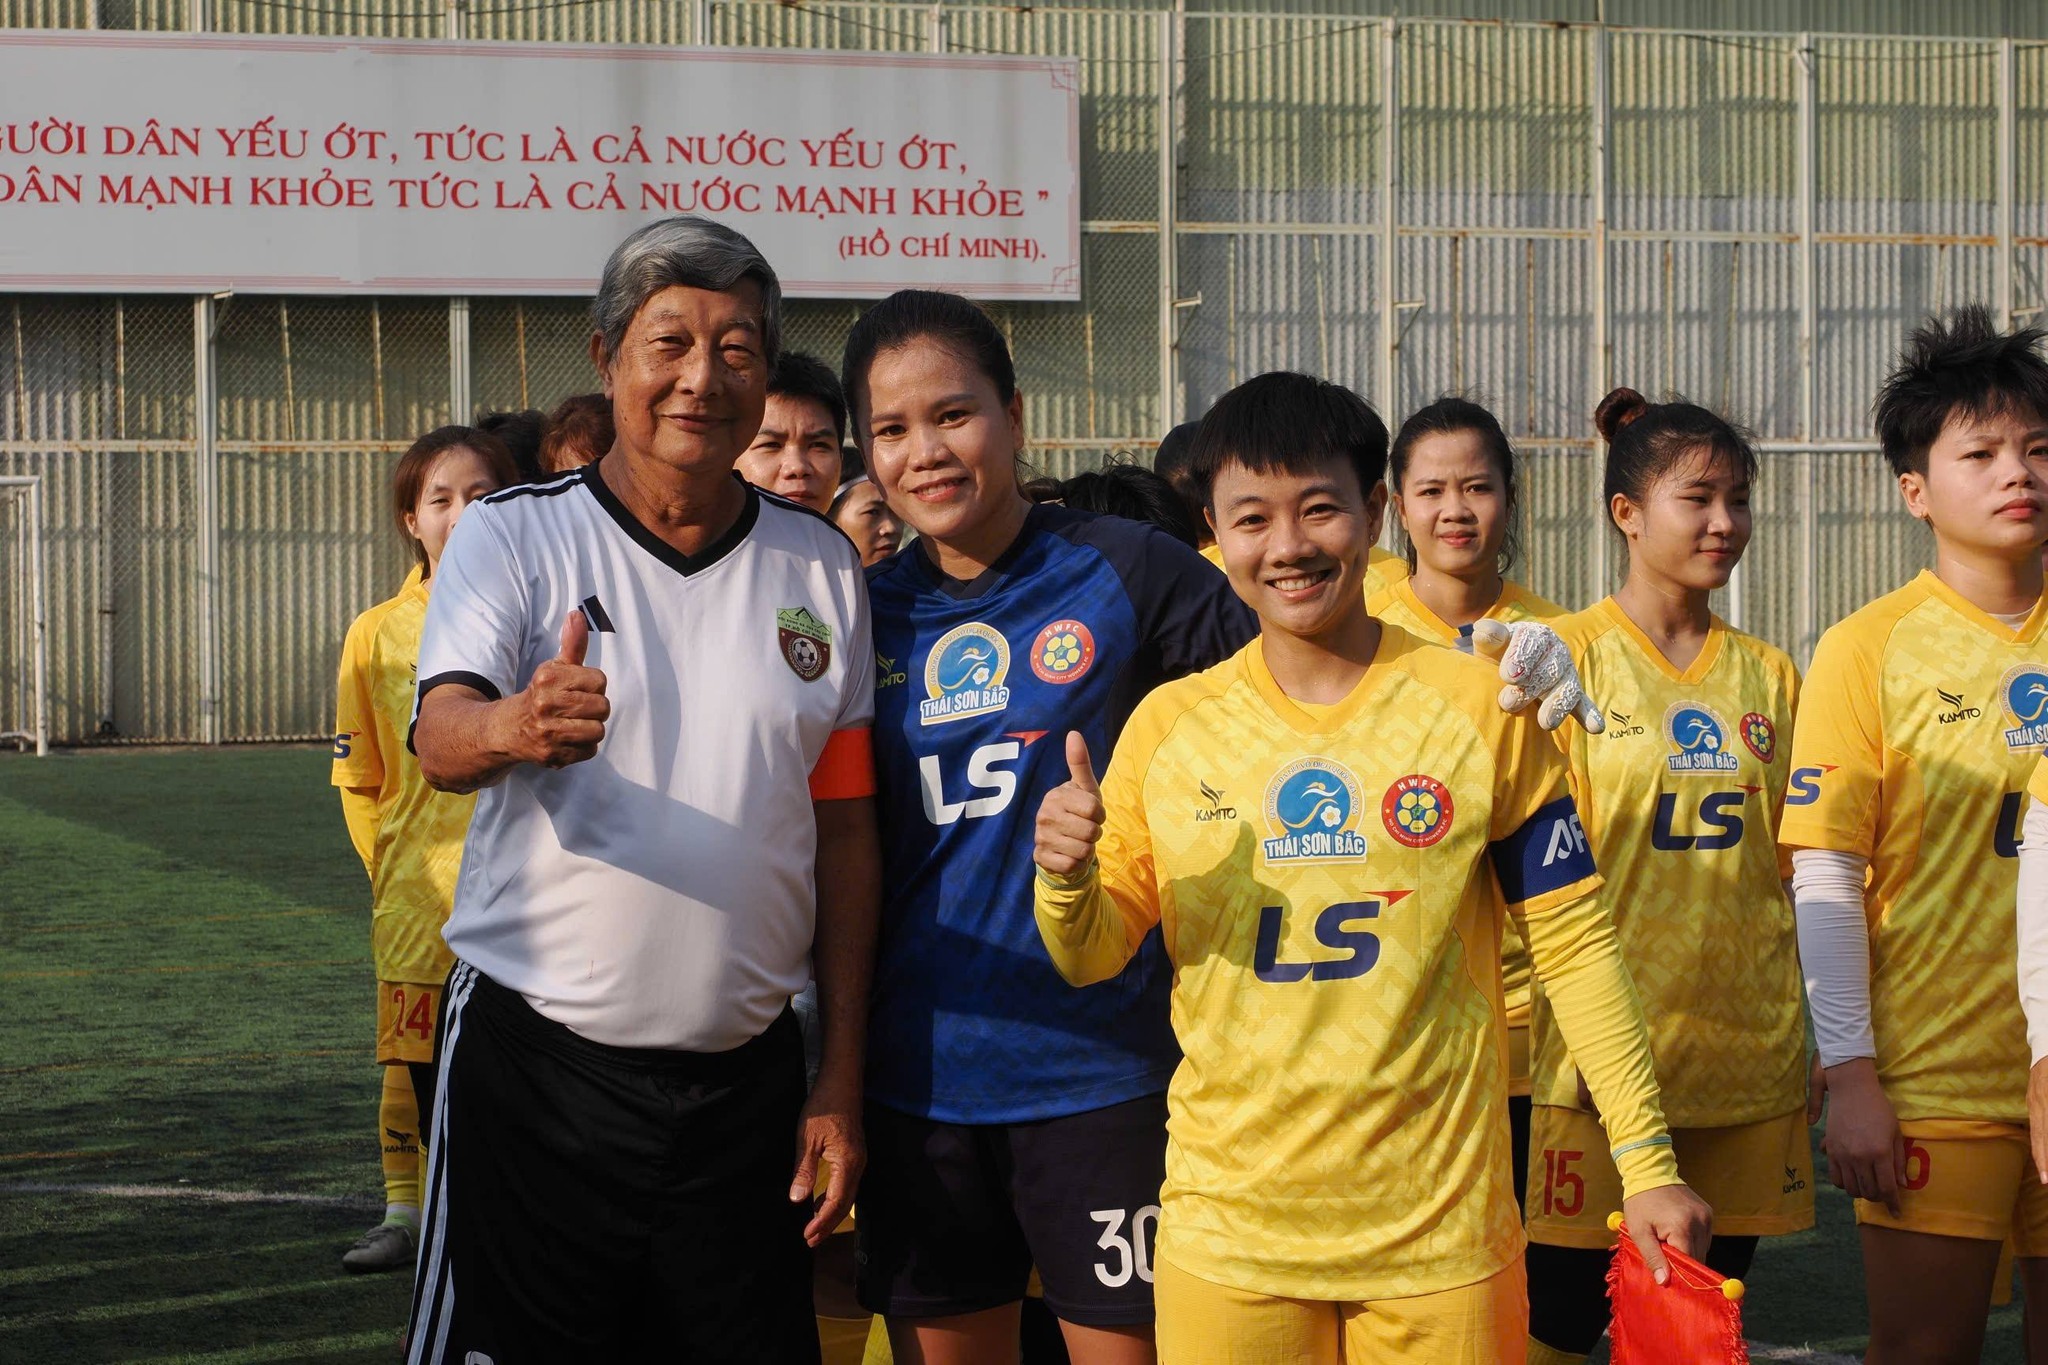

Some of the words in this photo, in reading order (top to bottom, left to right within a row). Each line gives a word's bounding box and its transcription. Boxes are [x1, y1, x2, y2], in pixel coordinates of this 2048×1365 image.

[0, 117, 88, 156] UỜI
[105, 119, 202, 158] DÂN
[217, 116, 310, 160] YẾU
[325, 123, 400, 164] ỚT,
[416, 125, 506, 163] TỨC
[522, 128, 579, 165] LÀ
[593, 126, 652, 165] CẢ
[668, 130, 787, 168] NƯỚC
[802, 129, 885, 171] YẾU
[899, 135, 968, 174] ỚT,
[100, 175, 233, 213] MẠNH
[251, 168, 375, 209] KHỎE
[389, 172, 480, 210] TỨC
[497, 173, 552, 211] LÀ
[567, 173, 627, 212] CẢ
[642, 177, 762, 214] NƯỚC
[776, 185, 897, 221] MẠNH
[839, 228, 892, 260] (HỒ
[901, 232, 951, 259] CHÍ
[961, 237, 1048, 262] MINH).
[877, 672, 906, 689] AMITO
[924, 694, 951, 717] THÁI
[954, 689, 979, 712] SƠN
[982, 686, 1006, 707] BẮC
[1938, 707, 1981, 725] KAMITO
[1609, 726, 1645, 740] KAMITO
[2007, 726, 2034, 746] THÁI
[1669, 752, 1692, 769] THÁI
[1693, 751, 1714, 770] SƠN
[1716, 752, 1737, 770] BẮC
[919, 741, 1020, 826] LS
[1397, 779, 1438, 792] HWFC
[1195, 807, 1237, 822] KAMITO
[1651, 792, 1745, 851] LS
[1266, 834, 1298, 857] THÁI
[1301, 831, 1331, 856] SƠN
[1335, 832, 1364, 855] BẮC
[1253, 900, 1381, 983] LS
[394, 988, 433, 1040] 24
[1543, 1149, 1585, 1217] 15
[1089, 1204, 1162, 1288] 30
